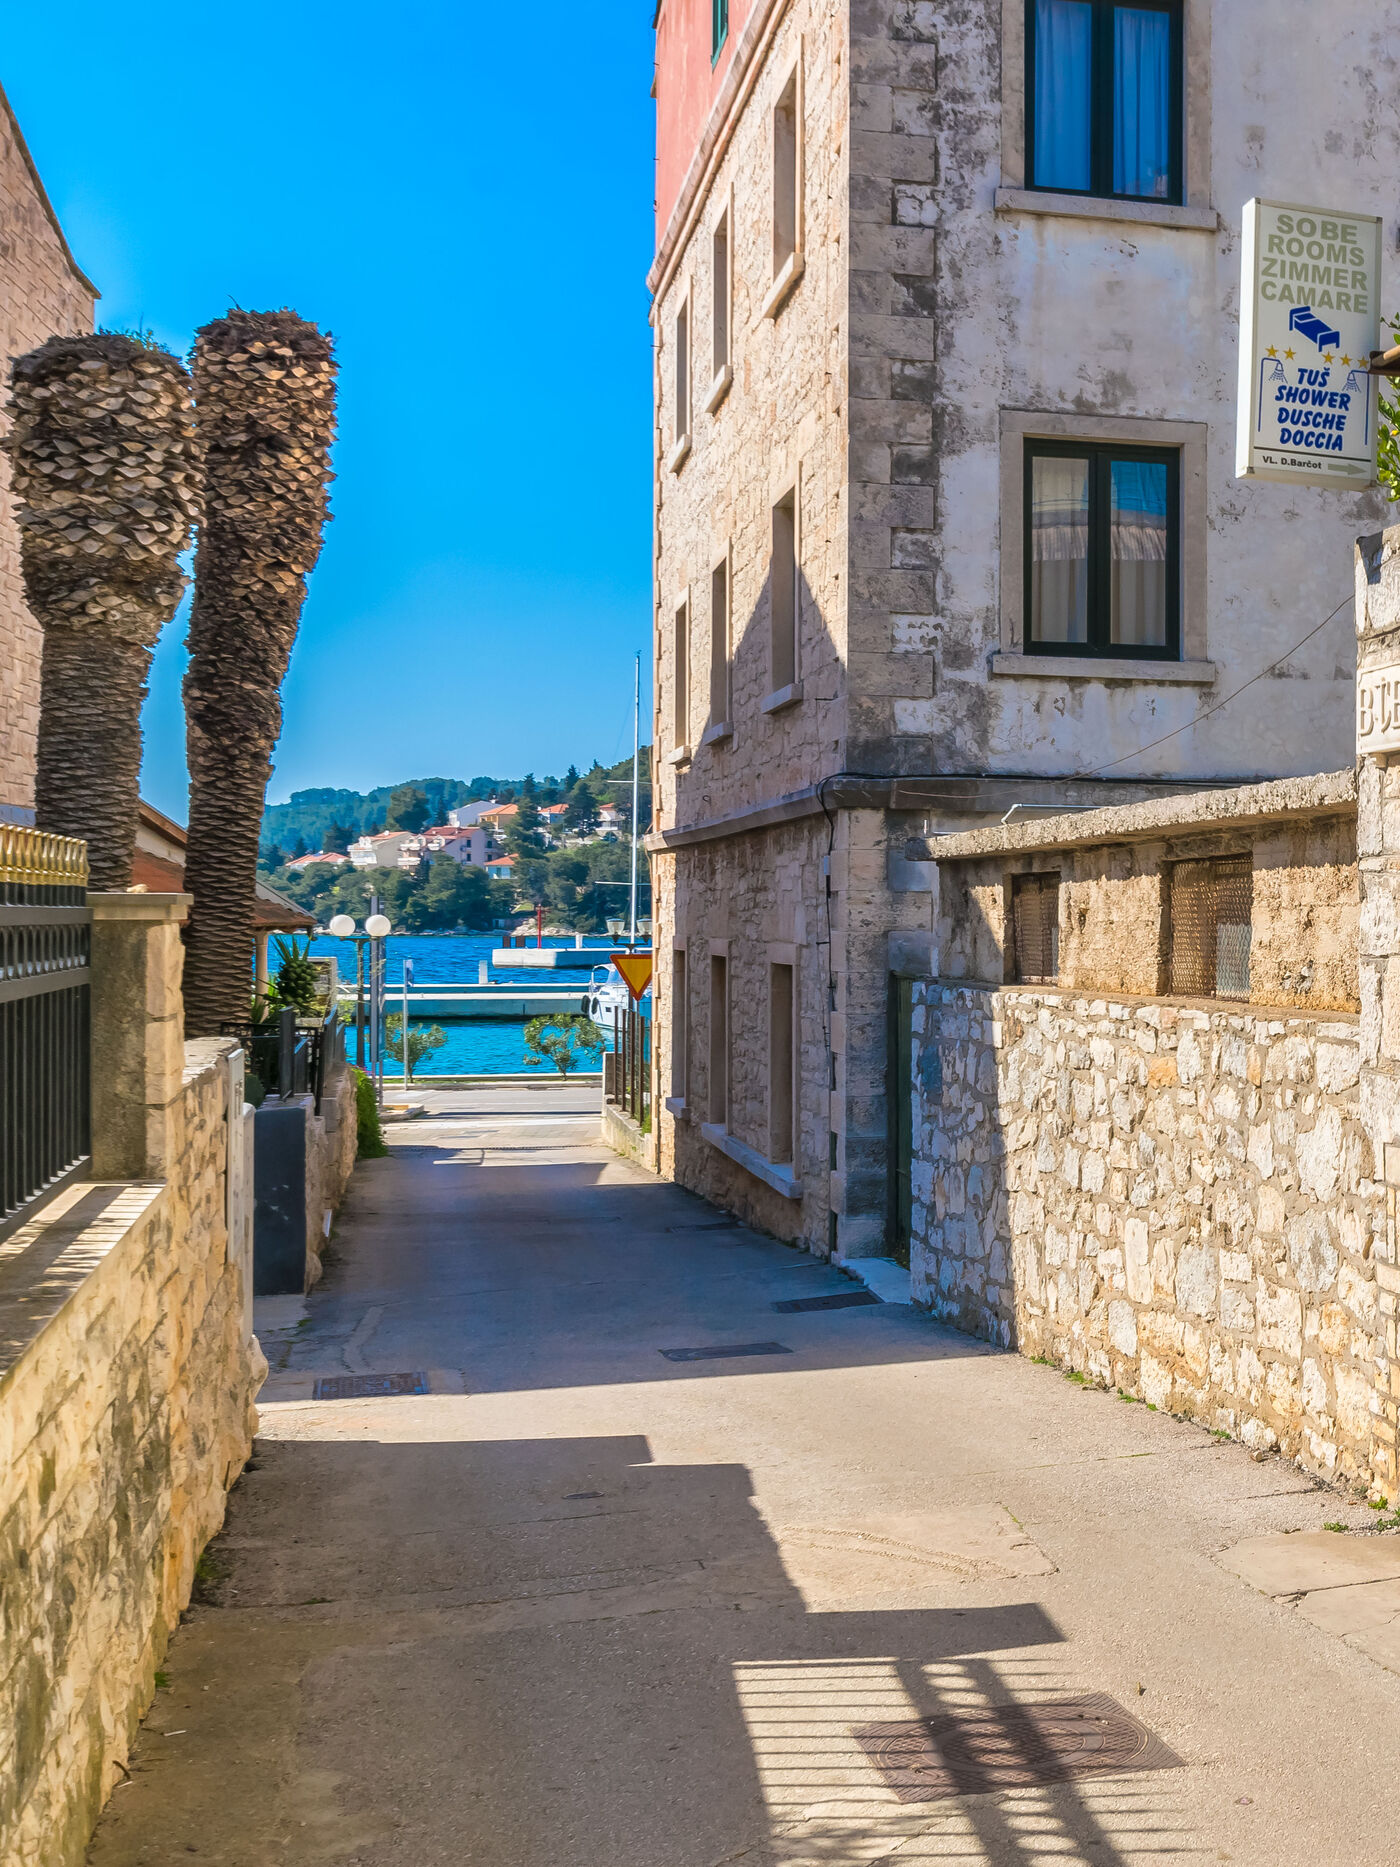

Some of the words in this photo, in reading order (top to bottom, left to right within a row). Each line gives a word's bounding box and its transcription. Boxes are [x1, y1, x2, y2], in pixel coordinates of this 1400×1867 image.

[1276, 214, 1358, 245] SOBE
[1267, 234, 1365, 267] ROOMS
[1261, 257, 1368, 292] ZIMMER
[1261, 281, 1368, 315] CAMARE
[1297, 367, 1331, 388] TUŠ
[1275, 385, 1351, 411] SHOWER
[1277, 406, 1347, 432] DUSCHE
[1280, 428, 1344, 451] DOCCIA
[1262, 455, 1278, 465] VL.
